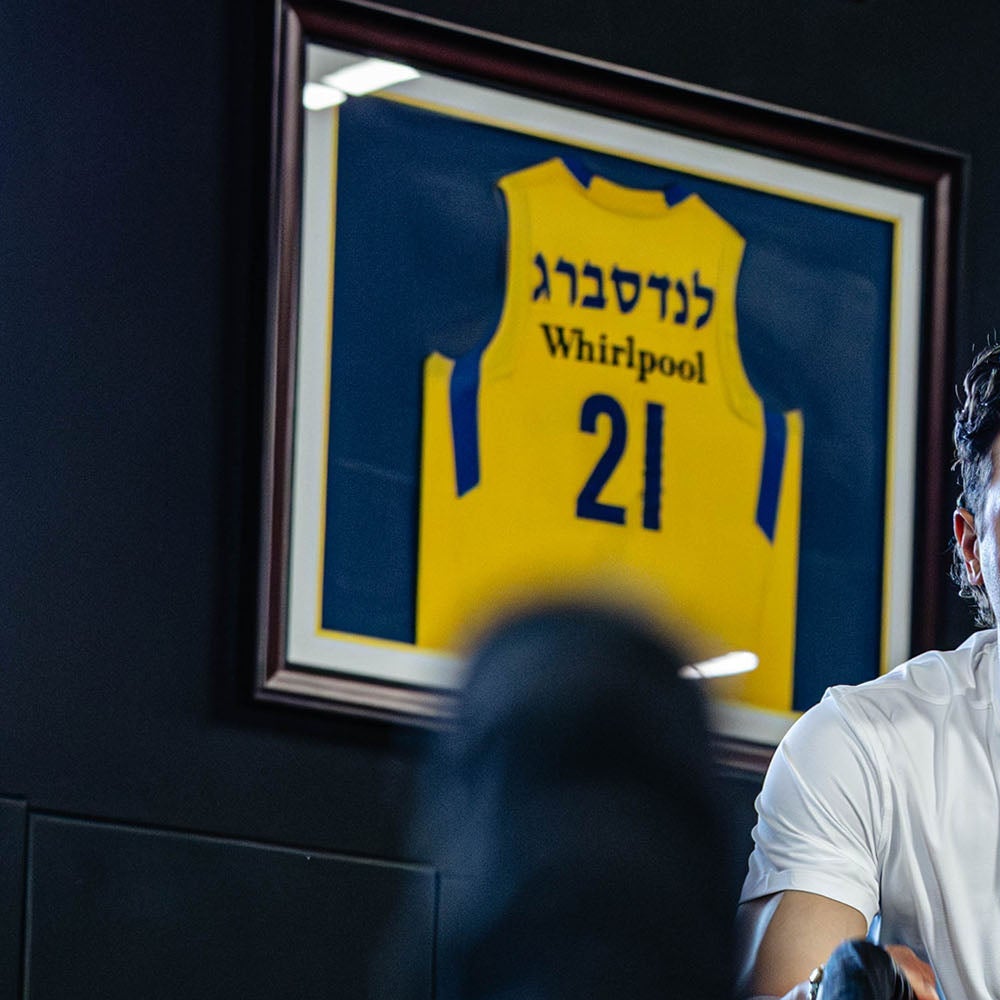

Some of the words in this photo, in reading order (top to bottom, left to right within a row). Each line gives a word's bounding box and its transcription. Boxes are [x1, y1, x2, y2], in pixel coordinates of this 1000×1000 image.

[531, 252, 715, 330] לנדסברג
[541, 323, 707, 384] Whirlpool
[575, 392, 665, 532] 21
